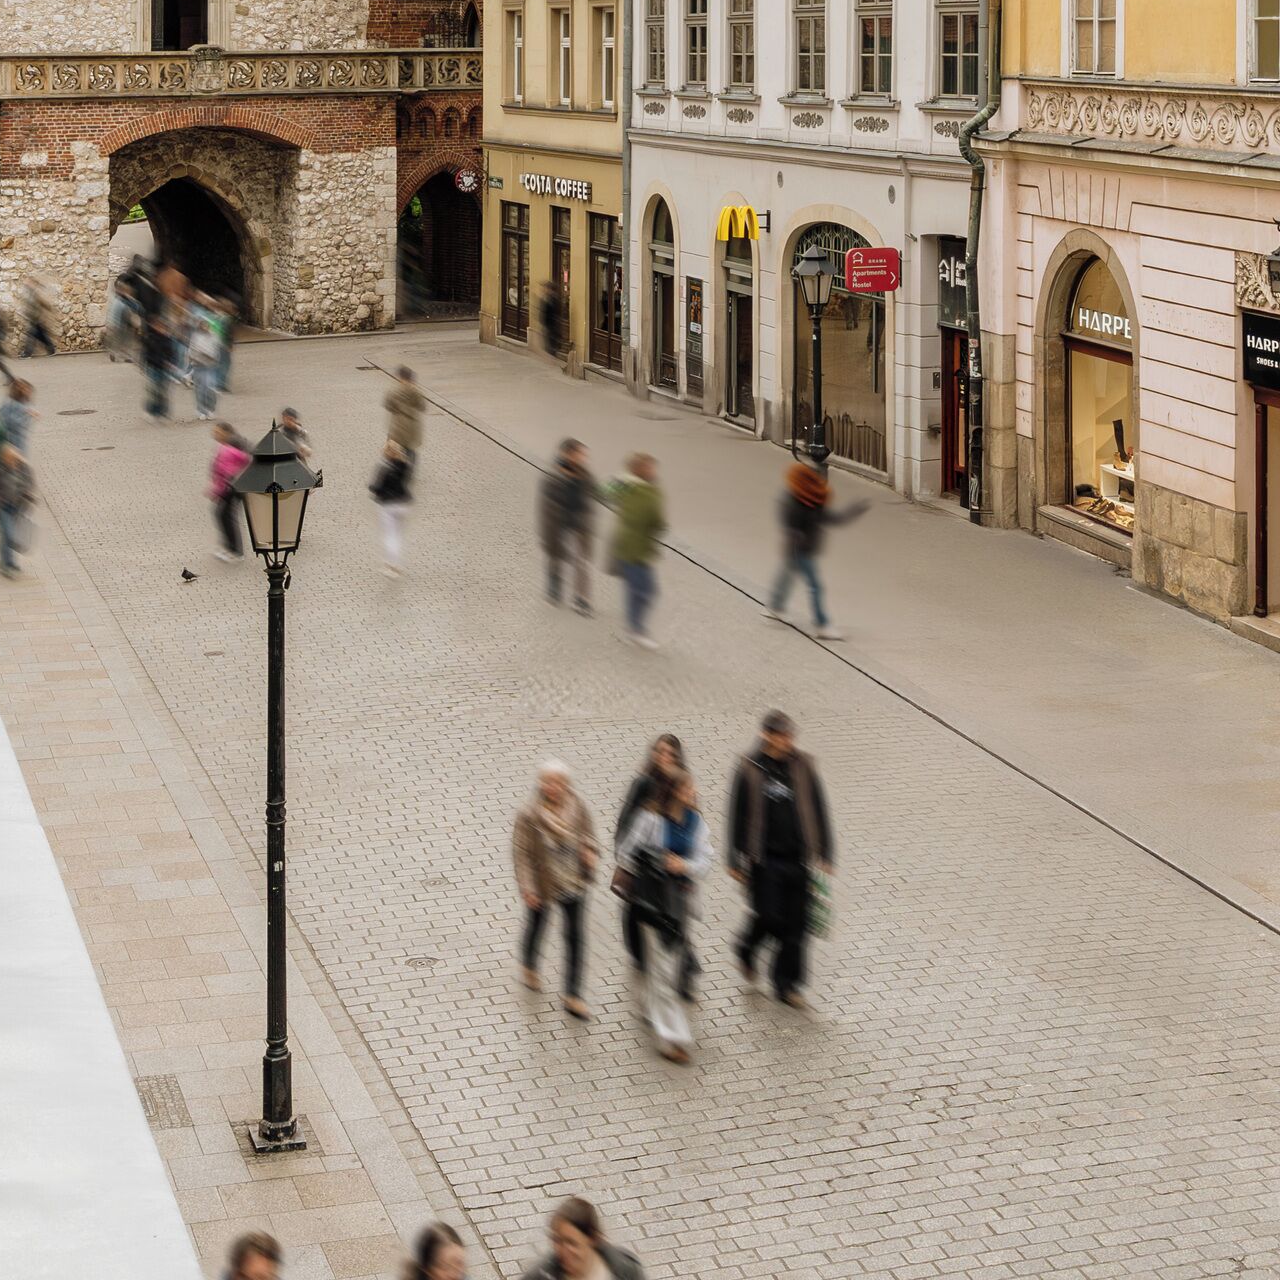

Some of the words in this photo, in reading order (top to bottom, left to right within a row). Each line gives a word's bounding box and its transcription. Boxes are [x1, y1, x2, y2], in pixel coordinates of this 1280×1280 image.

[524, 173, 551, 195] COSTA
[554, 177, 588, 200] COFFEE
[852, 269, 887, 277] Apartments
[1078, 307, 1132, 339] HARPE
[1256, 357, 1274, 368] SHOES
[1274, 362, 1280, 370] &
